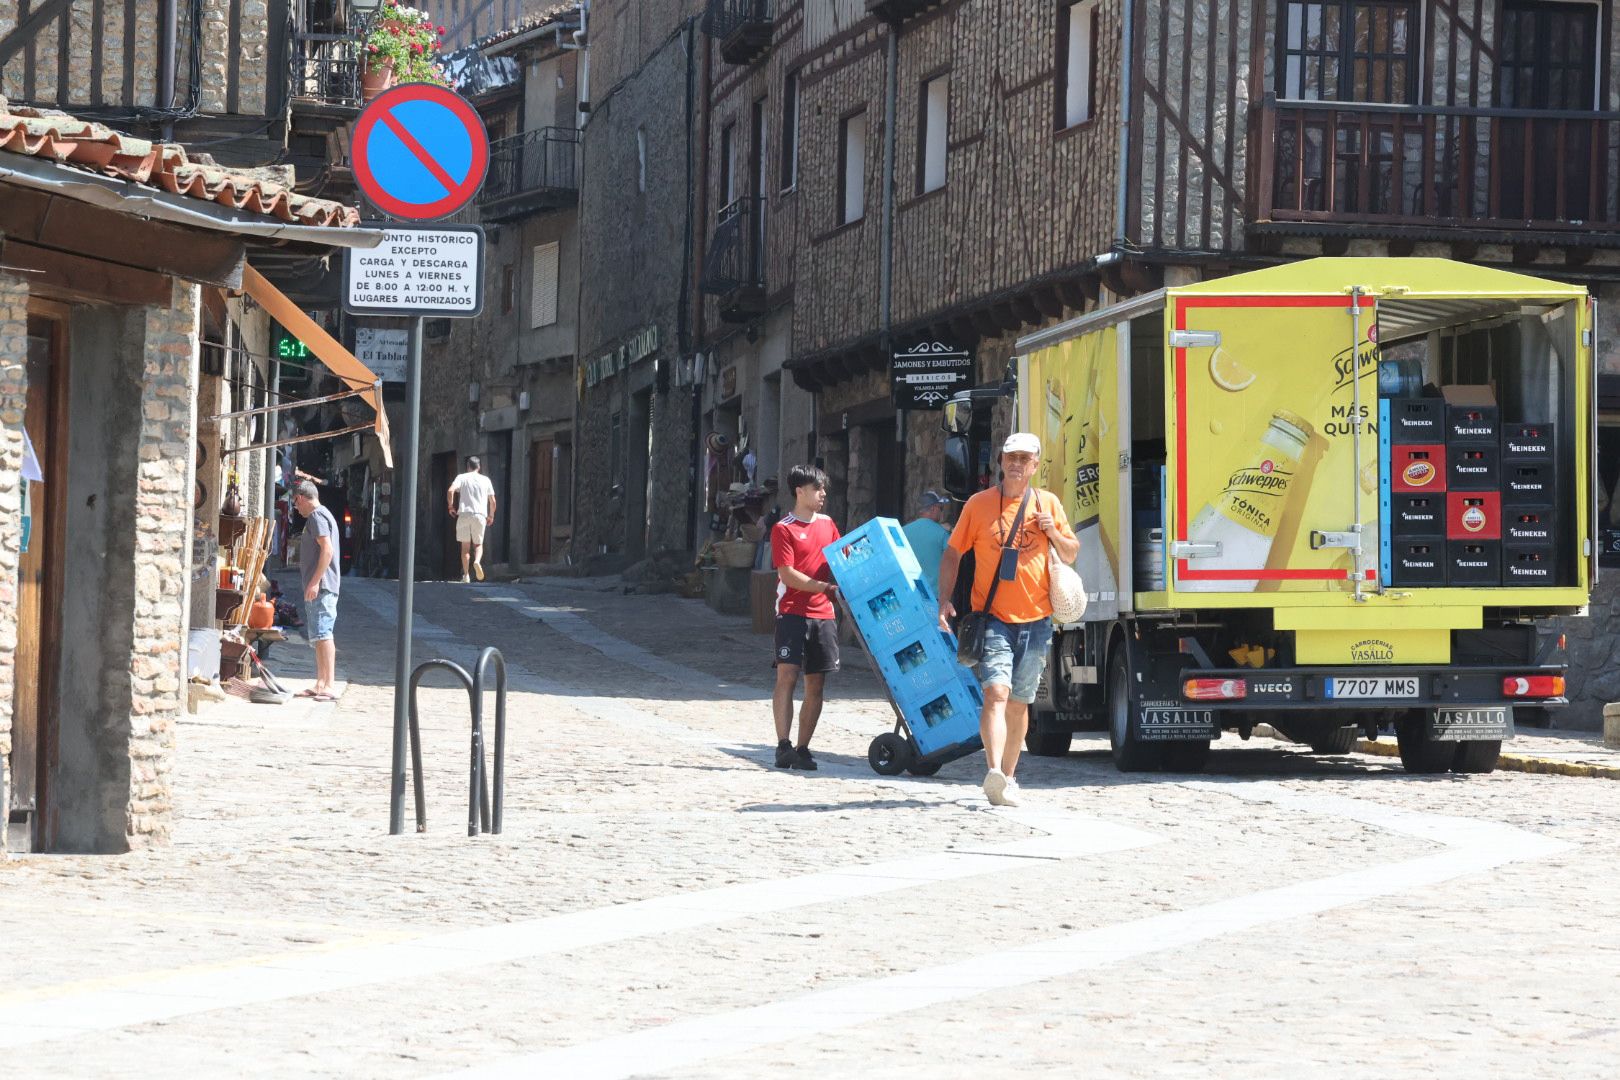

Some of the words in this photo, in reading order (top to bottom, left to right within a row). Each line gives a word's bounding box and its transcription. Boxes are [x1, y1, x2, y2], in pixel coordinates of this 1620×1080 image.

[383, 233, 412, 242] UNTO
[417, 234, 473, 244] HISTÓRICO
[391, 246, 437, 255] EXCEPTO
[359, 258, 394, 266] CARGA
[401, 258, 407, 266] Y
[412, 259, 468, 268] DESCARGA
[365, 270, 399, 278] LUNES
[405, 271, 412, 279] A
[418, 271, 462, 280] VIERNES
[356, 282, 370, 290] DE
[375, 283, 398, 291] 8:00
[416, 284, 442, 292] 12:00
[447, 285, 458, 293] H.
[463, 285, 470, 293] Y
[353, 294, 398, 303] LUGARES
[404, 295, 472, 305] AUTORIZADOS
[363, 351, 373, 360] El
[894, 360, 926, 369] JAMONES
[926, 360, 932, 368] Y
[932, 359, 971, 367] EMBUTIDOS
[1331, 402, 1369, 418] MÁS
[1223, 472, 1287, 490] Schweppes
[1232, 496, 1270, 526] TÓNICA
[1351, 650, 1394, 660] VASALLO
[1254, 683, 1293, 693] IVECO
[1337, 680, 1379, 695] 7707
[1385, 680, 1416, 695] MMS
[1140, 709, 1212, 724] VASALLO
[1433, 709, 1505, 724] VASALLO
